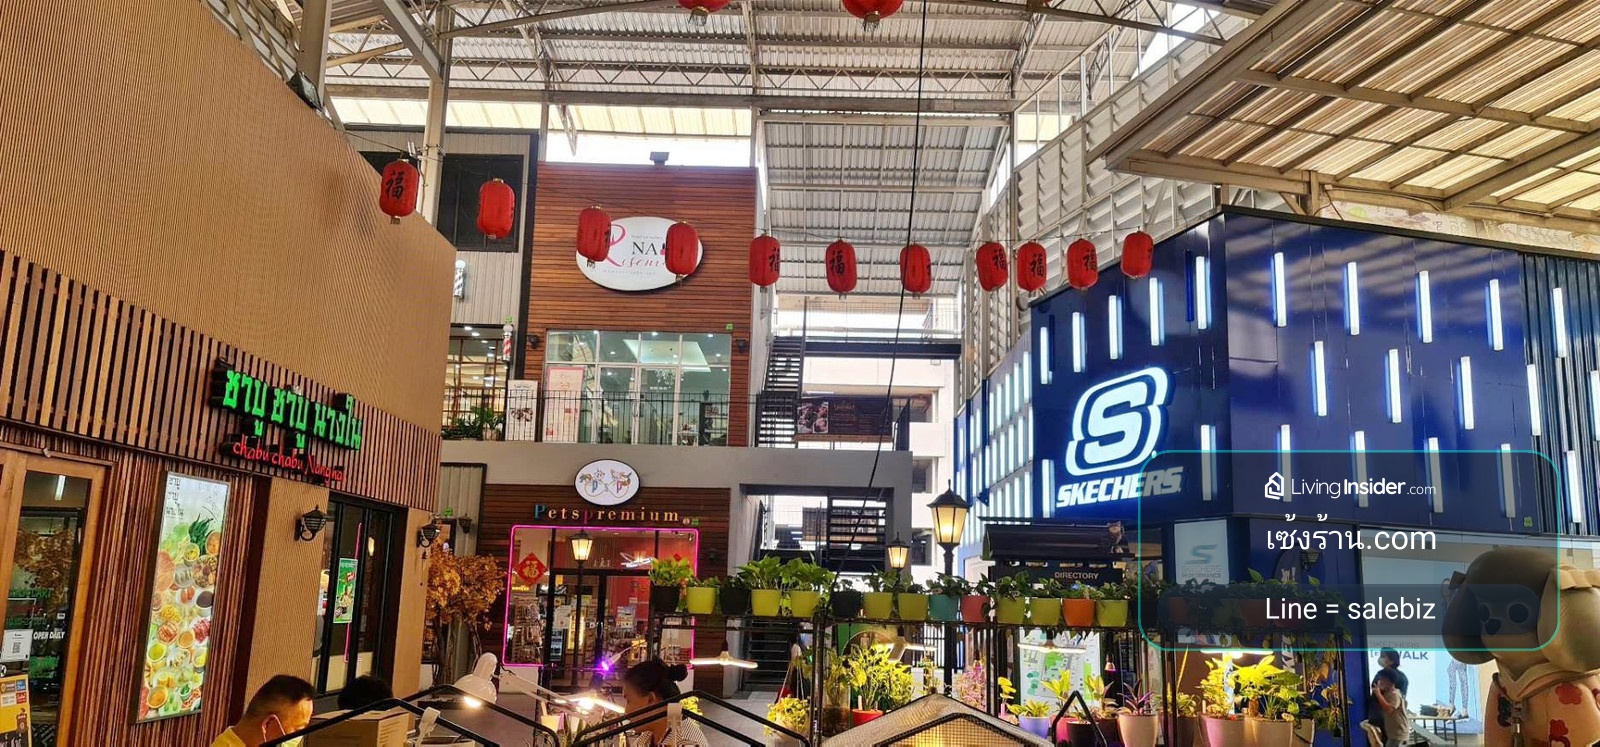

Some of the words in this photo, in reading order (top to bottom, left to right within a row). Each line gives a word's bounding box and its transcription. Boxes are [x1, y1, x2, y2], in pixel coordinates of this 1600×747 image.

[385, 171, 405, 201] 福
[829, 251, 845, 276] 福
[1029, 253, 1045, 278] 福
[223, 370, 268, 437] ชาบู
[271, 388, 309, 449] ชาบู
[313, 394, 362, 450] นางใน
[233, 435, 269, 462] chabu
[271, 448, 304, 470] chabu
[1056, 466, 1183, 508] SKECHERS
[534, 504, 679, 524] Petspremium
[1054, 571, 1099, 580] DIRECTORY
[1181, 565, 1221, 573] SKECHERS
[33, 631, 49, 640] OPEN
[49, 631, 66, 640] DAILY
[1370, 641, 1420, 649] SKECHERS
